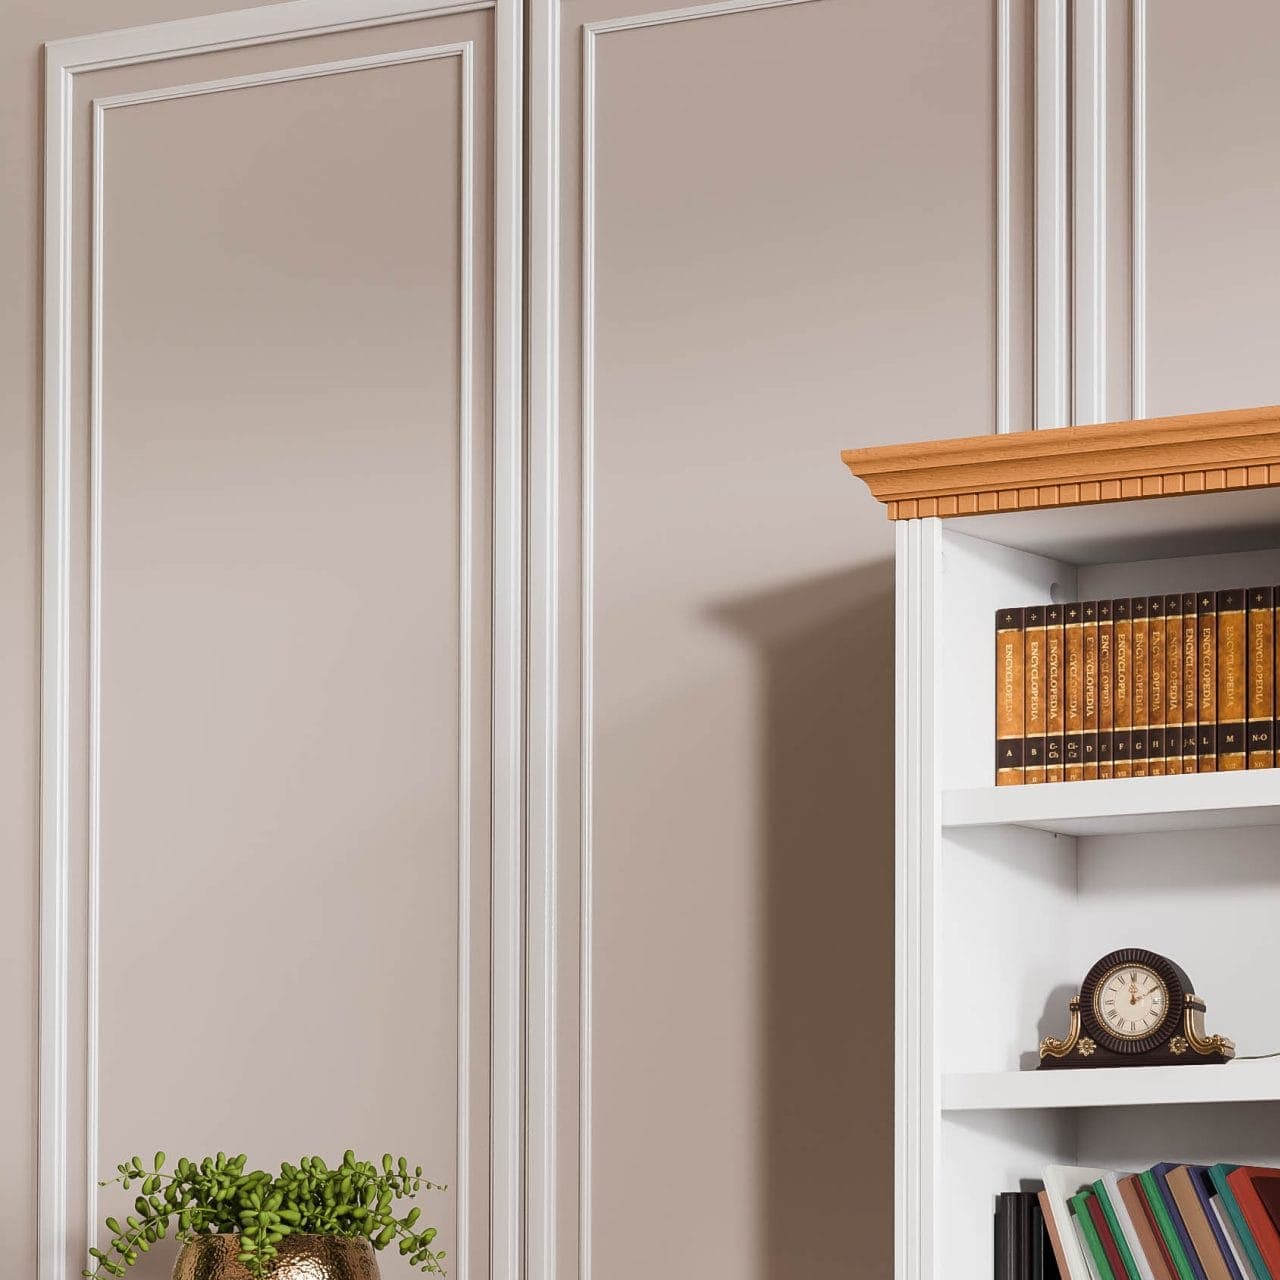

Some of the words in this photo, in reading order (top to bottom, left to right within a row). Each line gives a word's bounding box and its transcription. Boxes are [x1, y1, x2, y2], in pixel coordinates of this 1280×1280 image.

[1031, 641, 1039, 721] ENCYCLOPEDIA
[1050, 639, 1058, 720] ENCYCLOPEDIA
[1203, 627, 1211, 709] ENCYCLOPEDIA
[1255, 623, 1264, 705] ENCYCLOPEDIA
